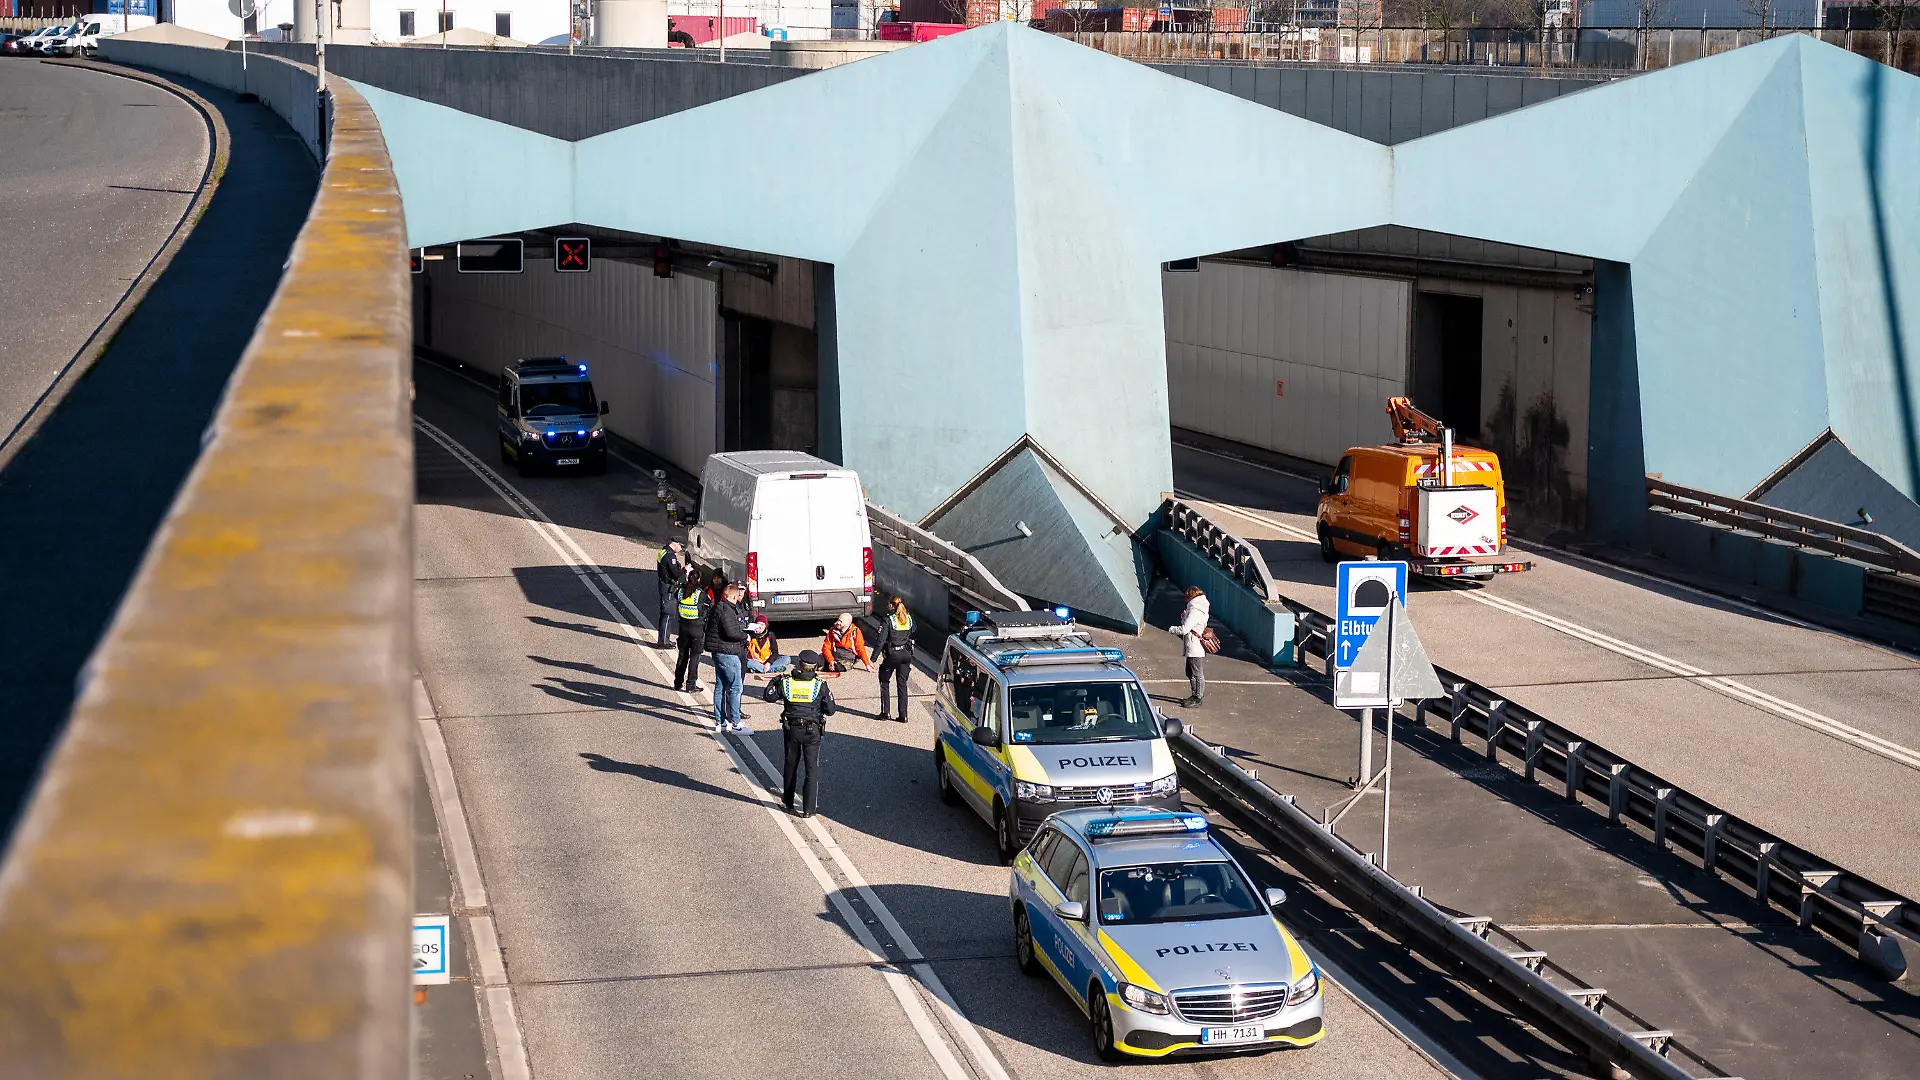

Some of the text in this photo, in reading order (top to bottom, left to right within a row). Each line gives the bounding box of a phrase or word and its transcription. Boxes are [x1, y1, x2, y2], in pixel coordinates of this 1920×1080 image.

[1058, 756, 1137, 770] POLIZEI
[1054, 933, 1075, 969] POLIZEI
[1155, 942, 1259, 958] POLIZEI
[1213, 1027, 1258, 1040] HH 7131
